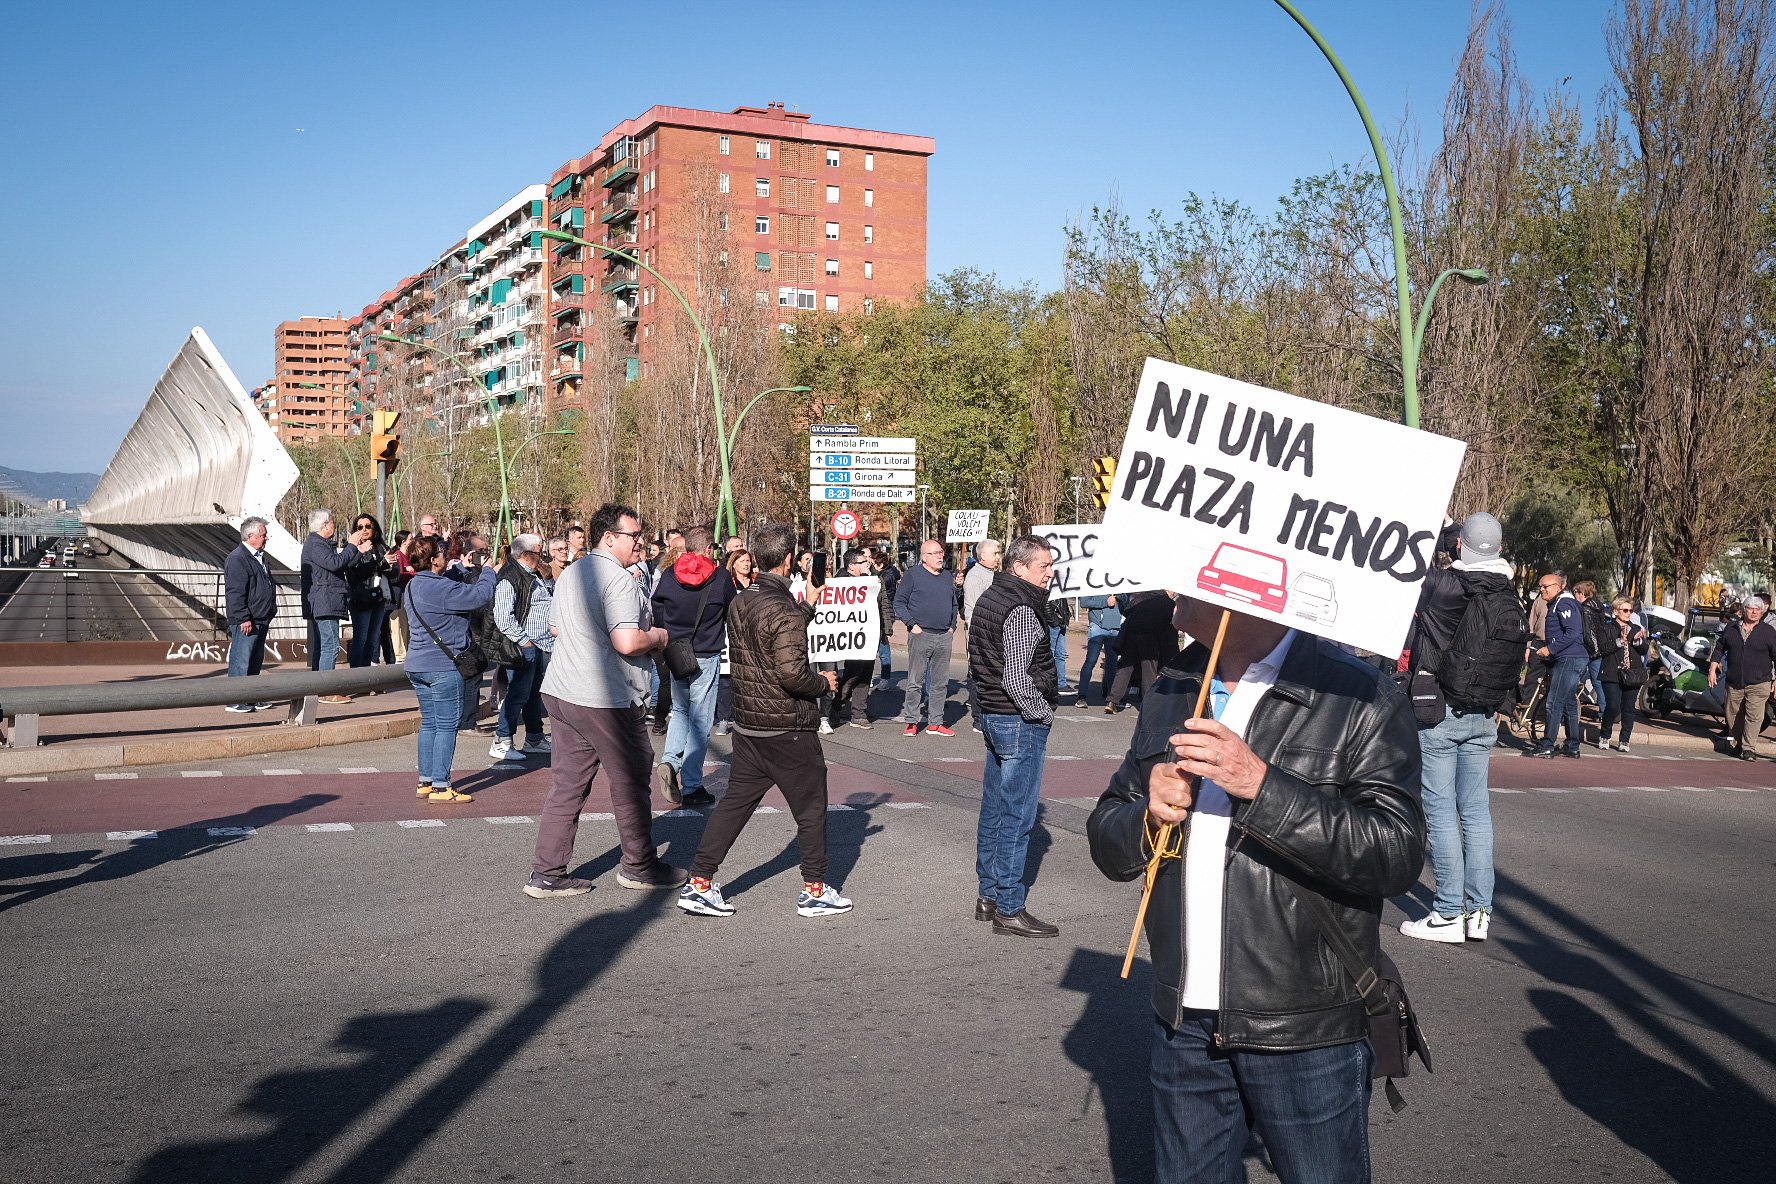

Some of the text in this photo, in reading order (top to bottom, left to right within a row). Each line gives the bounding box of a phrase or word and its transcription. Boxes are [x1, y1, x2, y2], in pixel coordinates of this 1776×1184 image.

[1146, 381, 1314, 477] NI UNA
[825, 438, 879, 448] Rambla Prim
[828, 456, 910, 466] B-10 Ronda Litoral
[828, 473, 883, 481] C-31 Girona
[828, 489, 847, 498] B-20
[851, 489, 875, 497] Ronda
[887, 490, 903, 498] Dalt
[1121, 451, 1435, 582] PLAZA MENOS
[814, 610, 868, 625] COLAU
